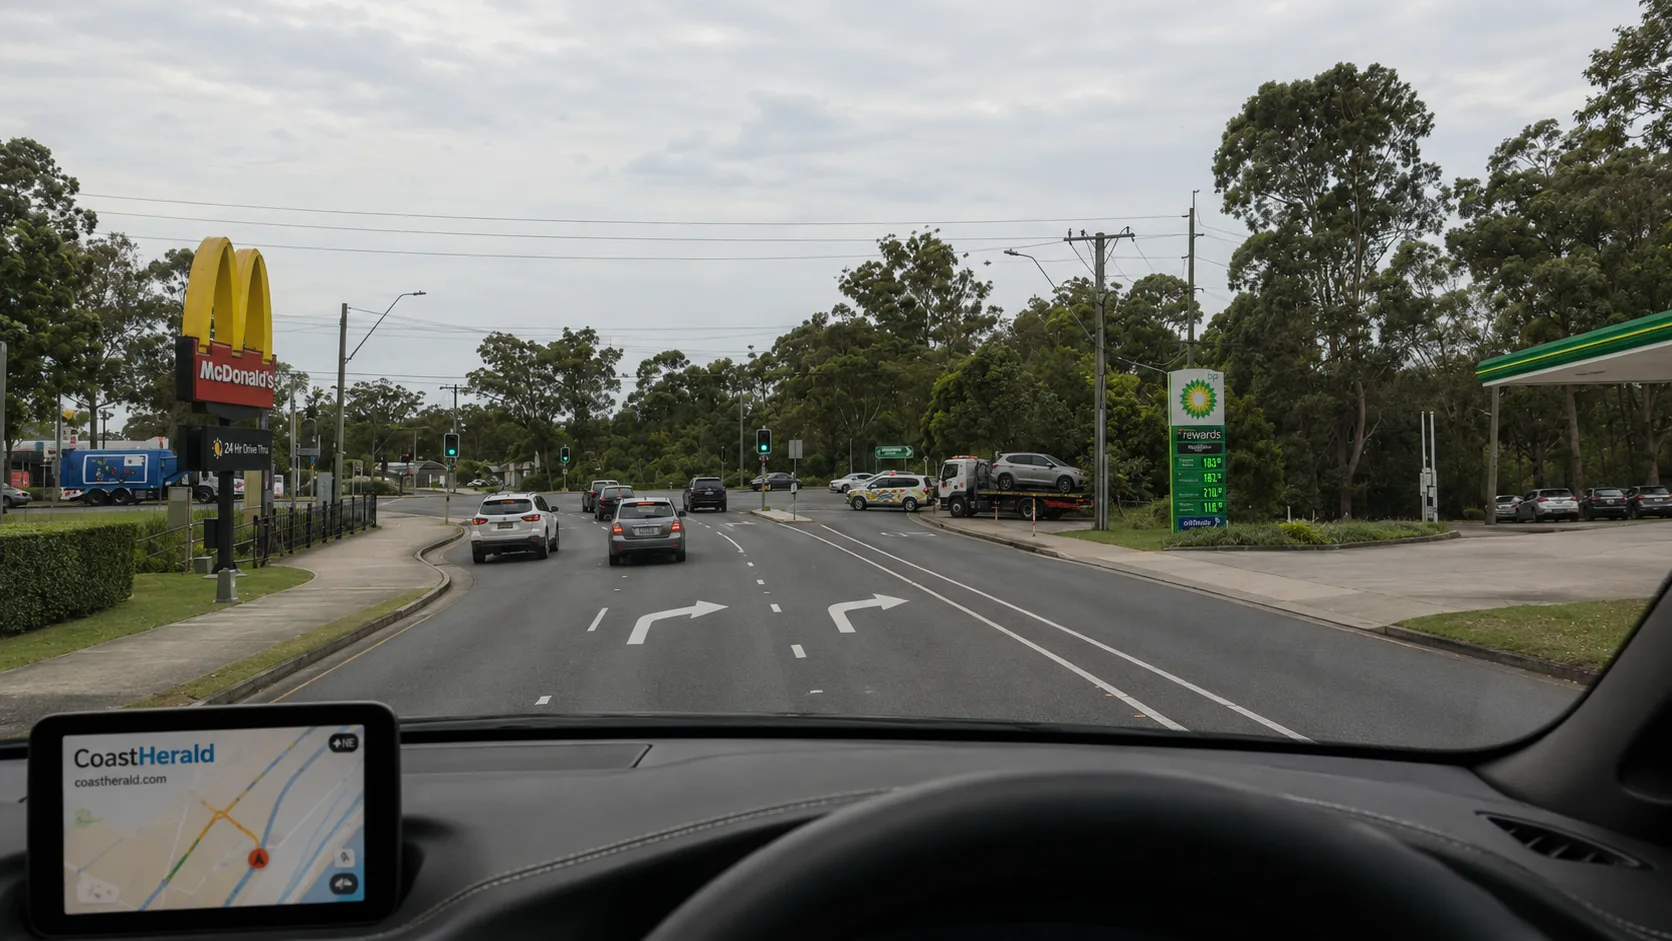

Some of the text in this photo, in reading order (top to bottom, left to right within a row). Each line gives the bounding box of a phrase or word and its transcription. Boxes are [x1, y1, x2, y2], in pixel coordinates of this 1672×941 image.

[200, 360, 274, 389] McDonald's
[1207, 372, 1219, 382] bp
[1182, 429, 1221, 440] rewards
[224, 442, 234, 454] 24
[234, 442, 243, 454] Hr
[243, 442, 258, 454] Drive
[341, 738, 355, 748] NE
[74, 743, 215, 769] CoastHerald
[74, 774, 167, 788] coastherald.com
